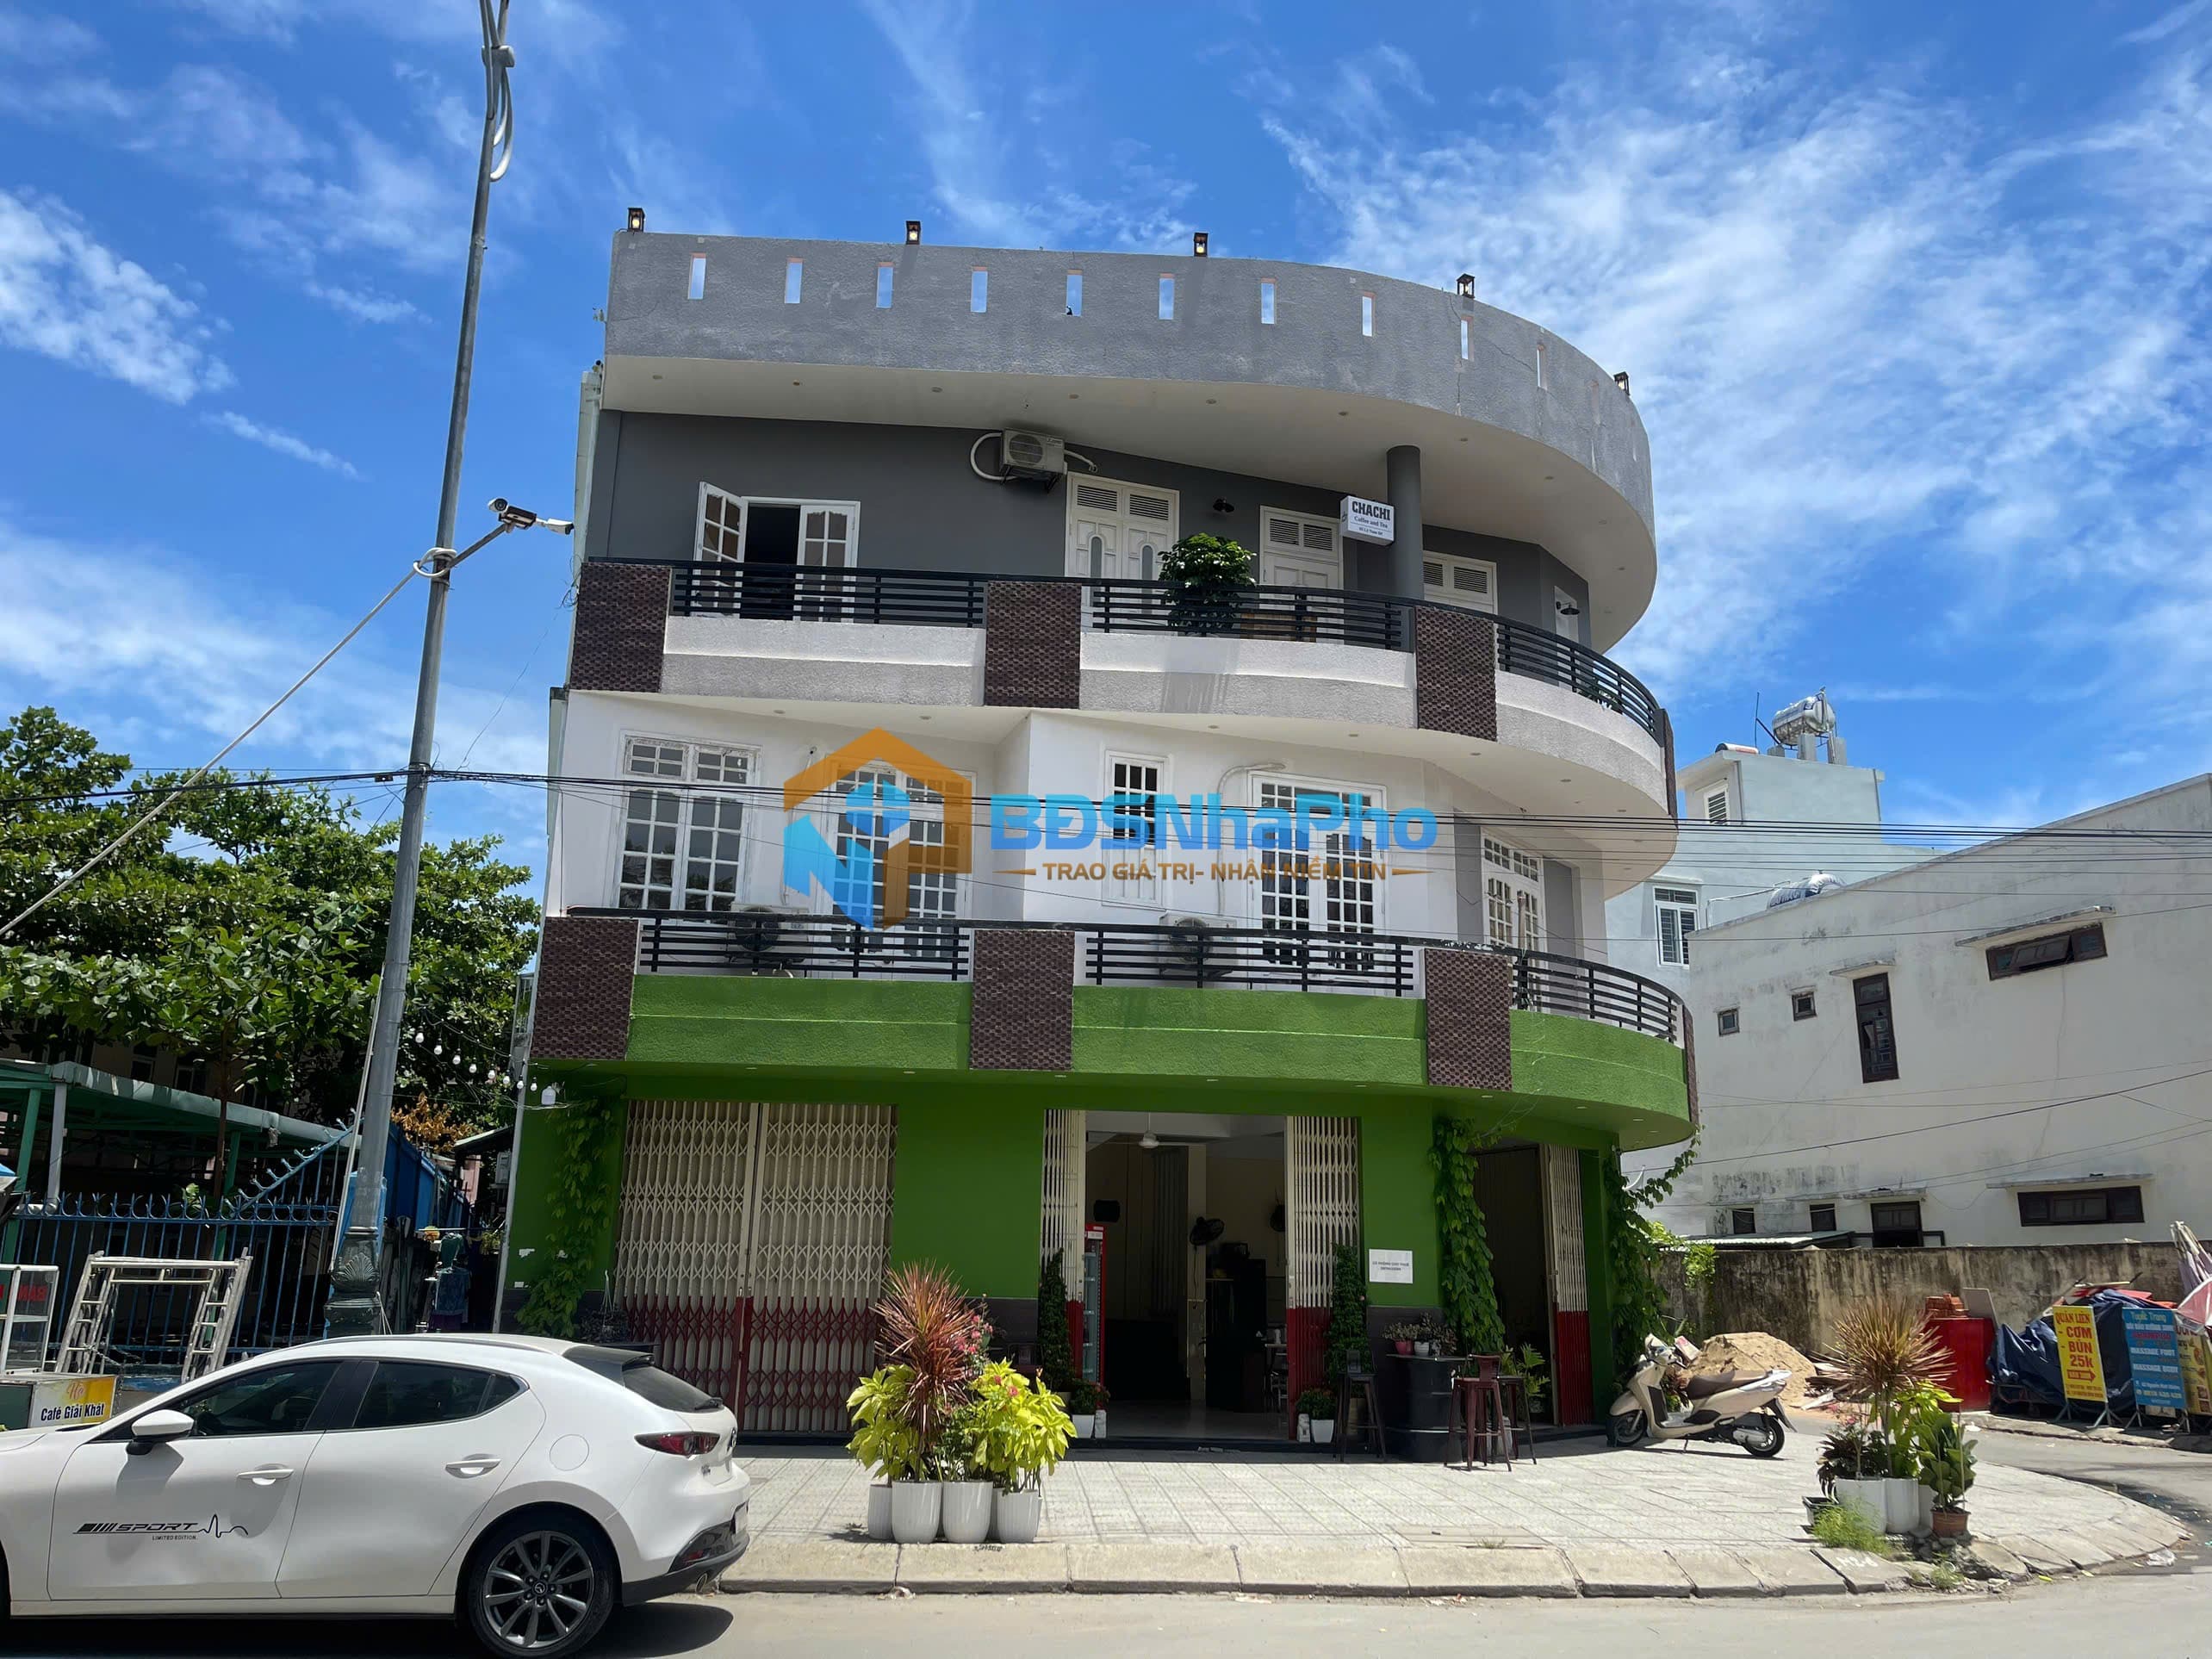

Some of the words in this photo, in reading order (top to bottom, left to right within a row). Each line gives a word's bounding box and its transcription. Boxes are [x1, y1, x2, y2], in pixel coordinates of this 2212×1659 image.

[1351, 500, 1391, 521] CHACHI
[2066, 1326, 2093, 1339] CƠM
[2068, 1339, 2093, 1353] BÚN
[40, 1406, 61, 1421] Café
[64, 1403, 82, 1420] Giải
[84, 1402, 104, 1417] Khát
[115, 1522, 199, 1532] SPORT
